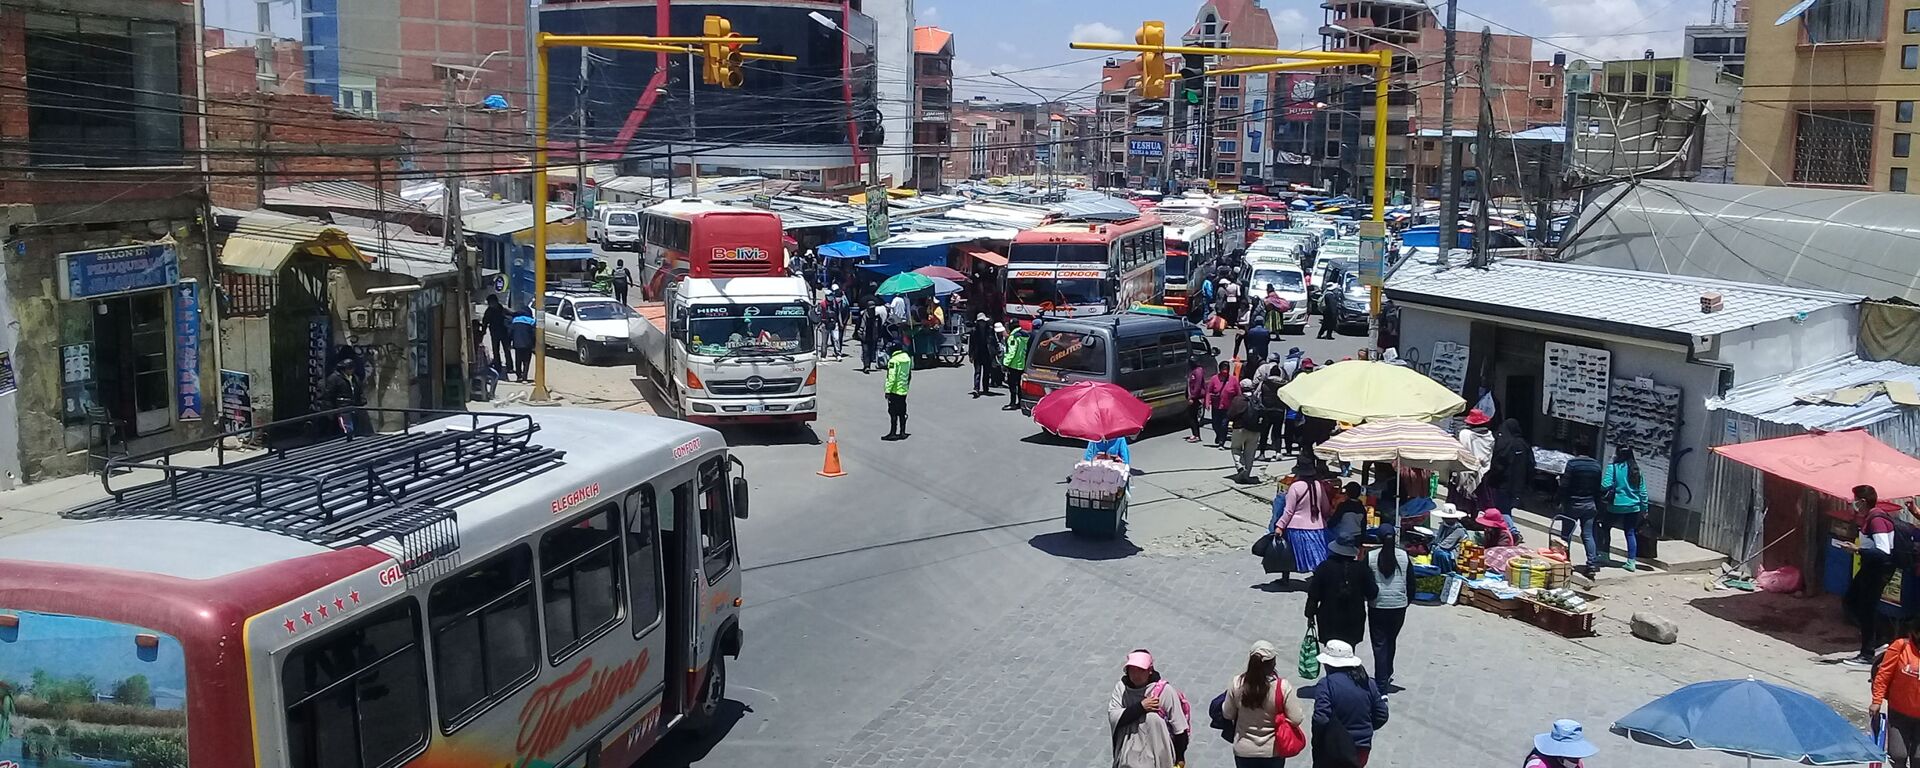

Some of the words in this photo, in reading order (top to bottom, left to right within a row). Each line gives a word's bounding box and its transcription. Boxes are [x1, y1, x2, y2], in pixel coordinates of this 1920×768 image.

[1131, 141, 1161, 150] YESHUA
[96, 248, 133, 260] SALON
[712, 247, 769, 260] Bolivia
[308, 322, 317, 411] PELUQUERIA
[673, 437, 701, 459] CONFORT
[551, 481, 600, 514] ELEGANCIA
[516, 647, 650, 768] Turismo
